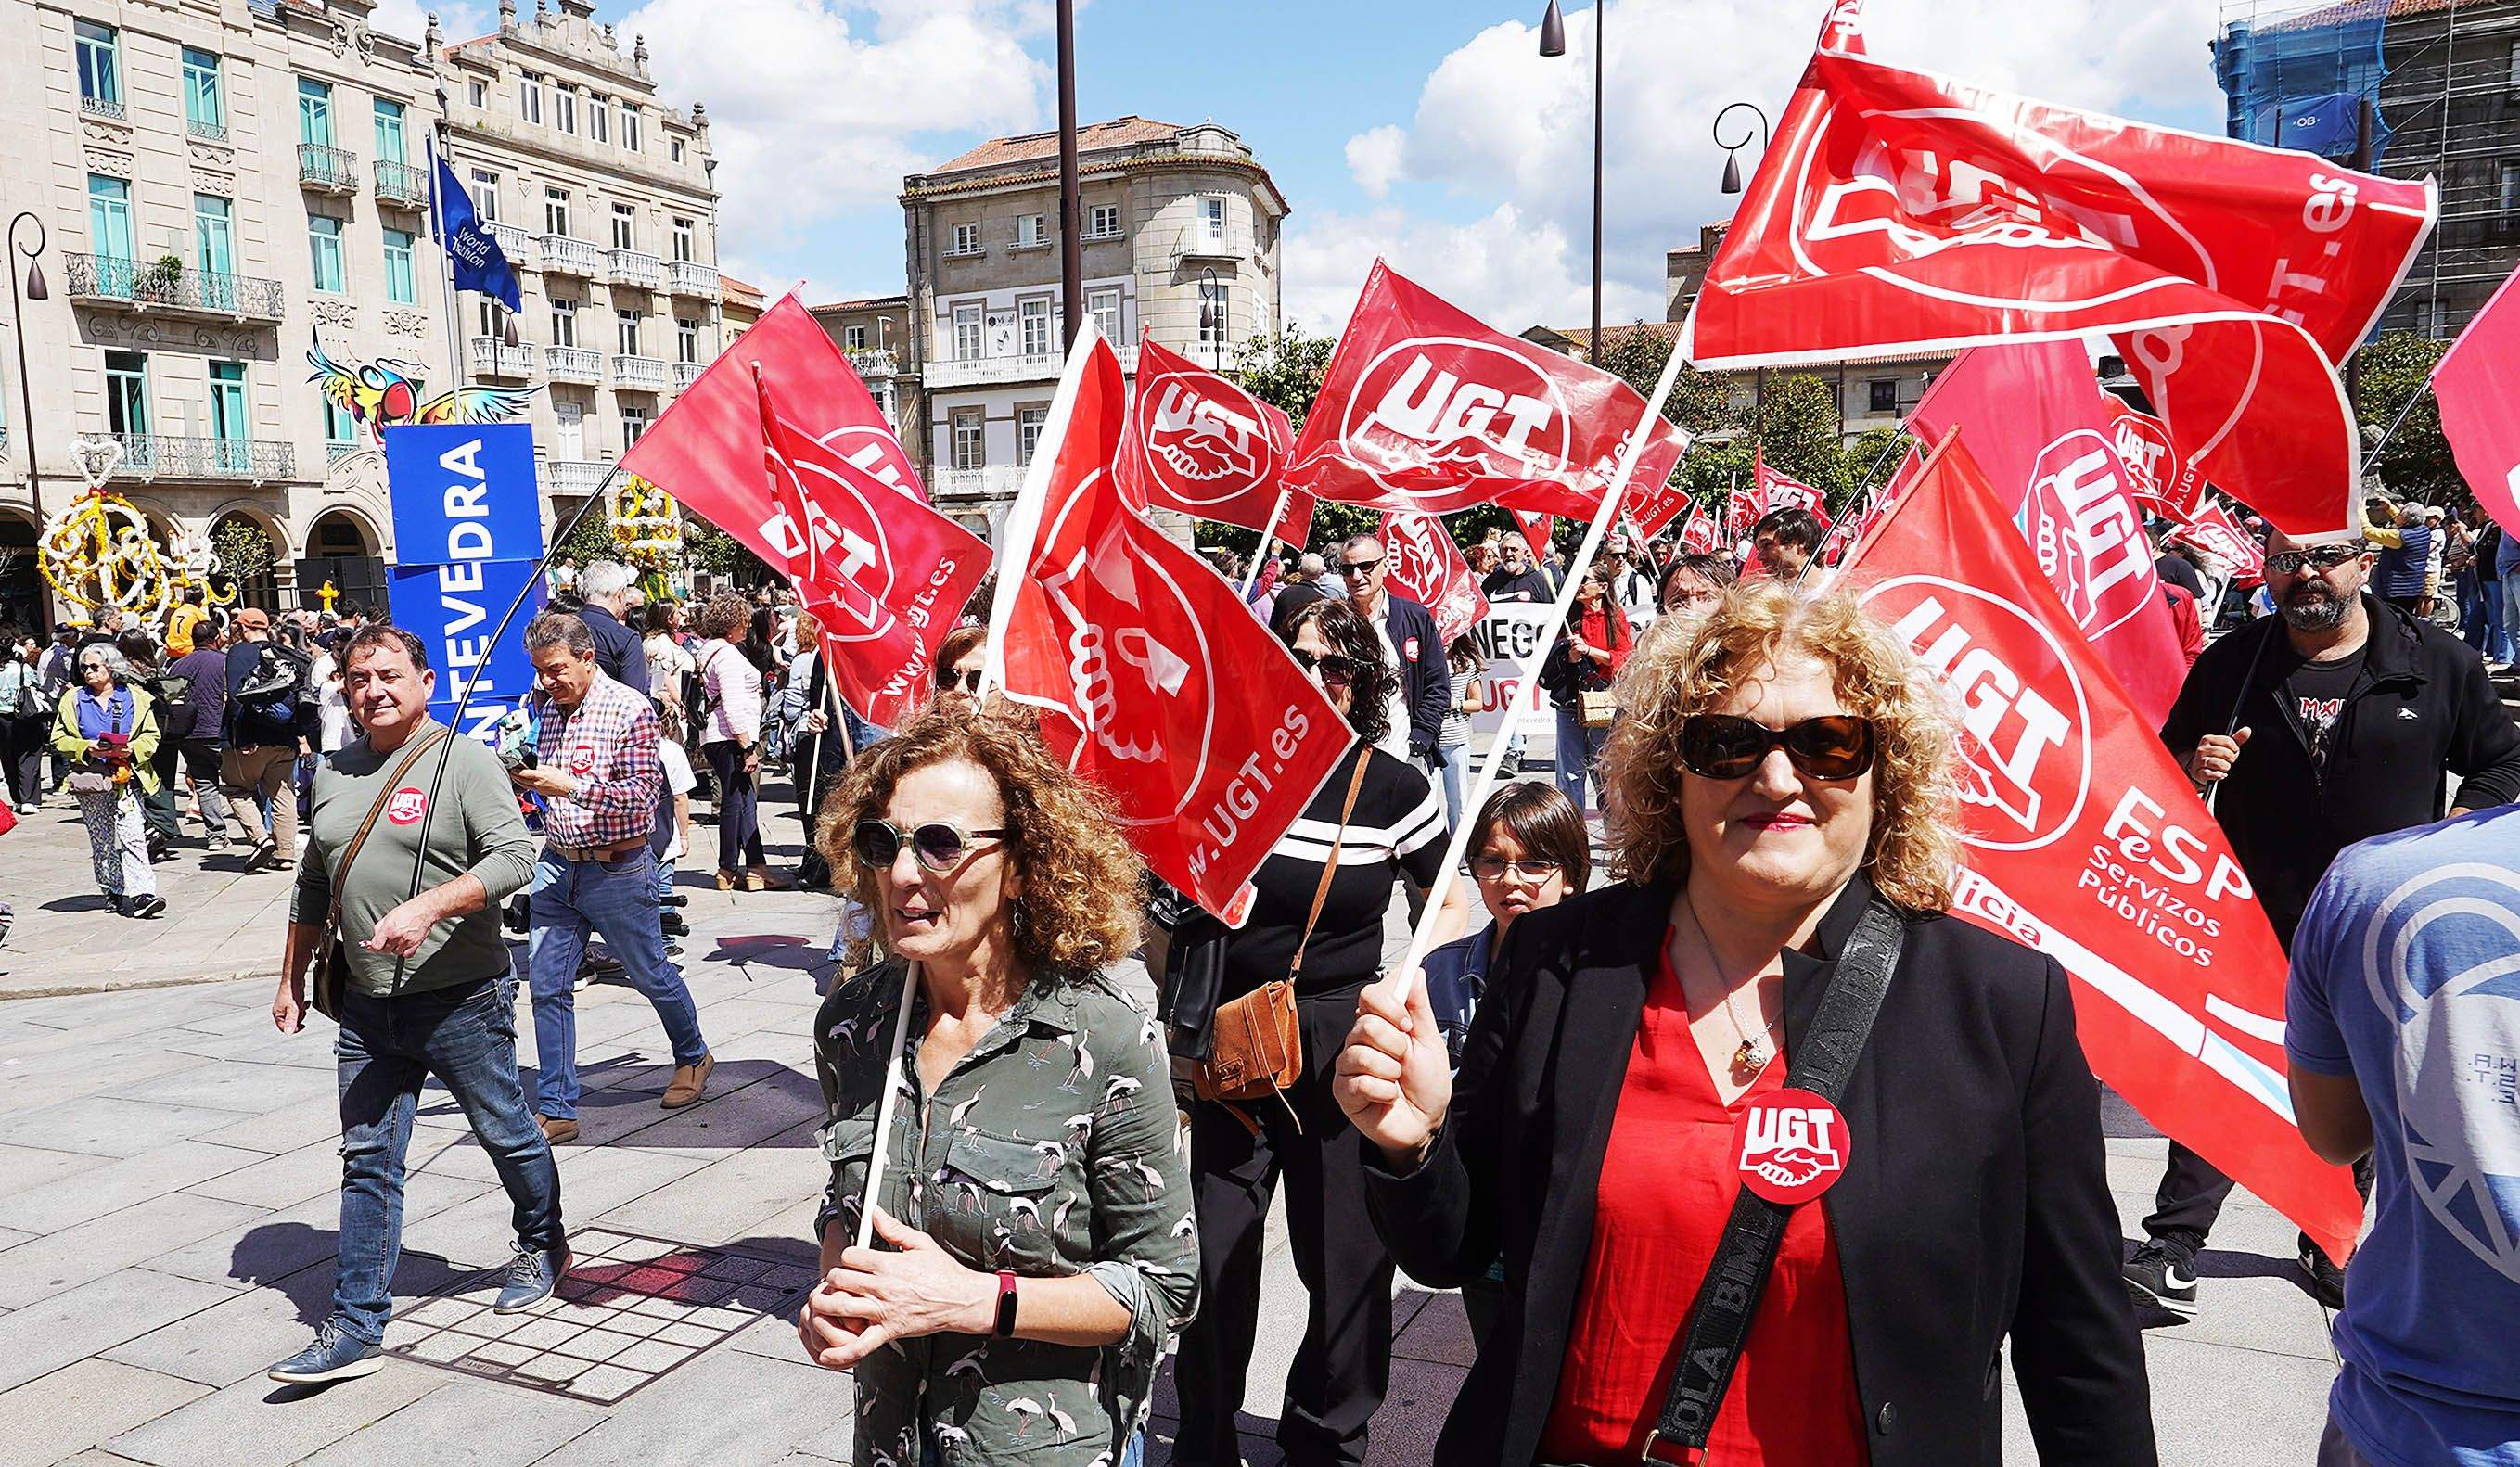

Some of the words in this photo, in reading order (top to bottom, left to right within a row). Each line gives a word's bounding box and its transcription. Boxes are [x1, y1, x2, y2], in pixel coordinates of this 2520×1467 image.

[452, 236, 485, 268] Tthlon
[459, 226, 491, 256] World
[2236, 173, 2359, 326] T.es
[1155, 381, 1258, 455] UGT
[1377, 353, 1554, 455] UGT
[2115, 422, 2166, 480] UGT
[1765, 480, 1817, 510] UGT
[2055, 447, 2152, 603] UGT
[176, 616, 185, 634] 7
[1889, 595, 2072, 789] UGT
[2299, 697, 2345, 721] MA
[394, 794, 424, 809] UGT
[2102, 785, 2254, 902] FeSP
[2077, 869, 2214, 967] Públicos
[2088, 845, 2221, 938] Servizos
[1744, 1107, 1836, 1152] UGT
[1712, 1208, 1775, 1315] BIM
